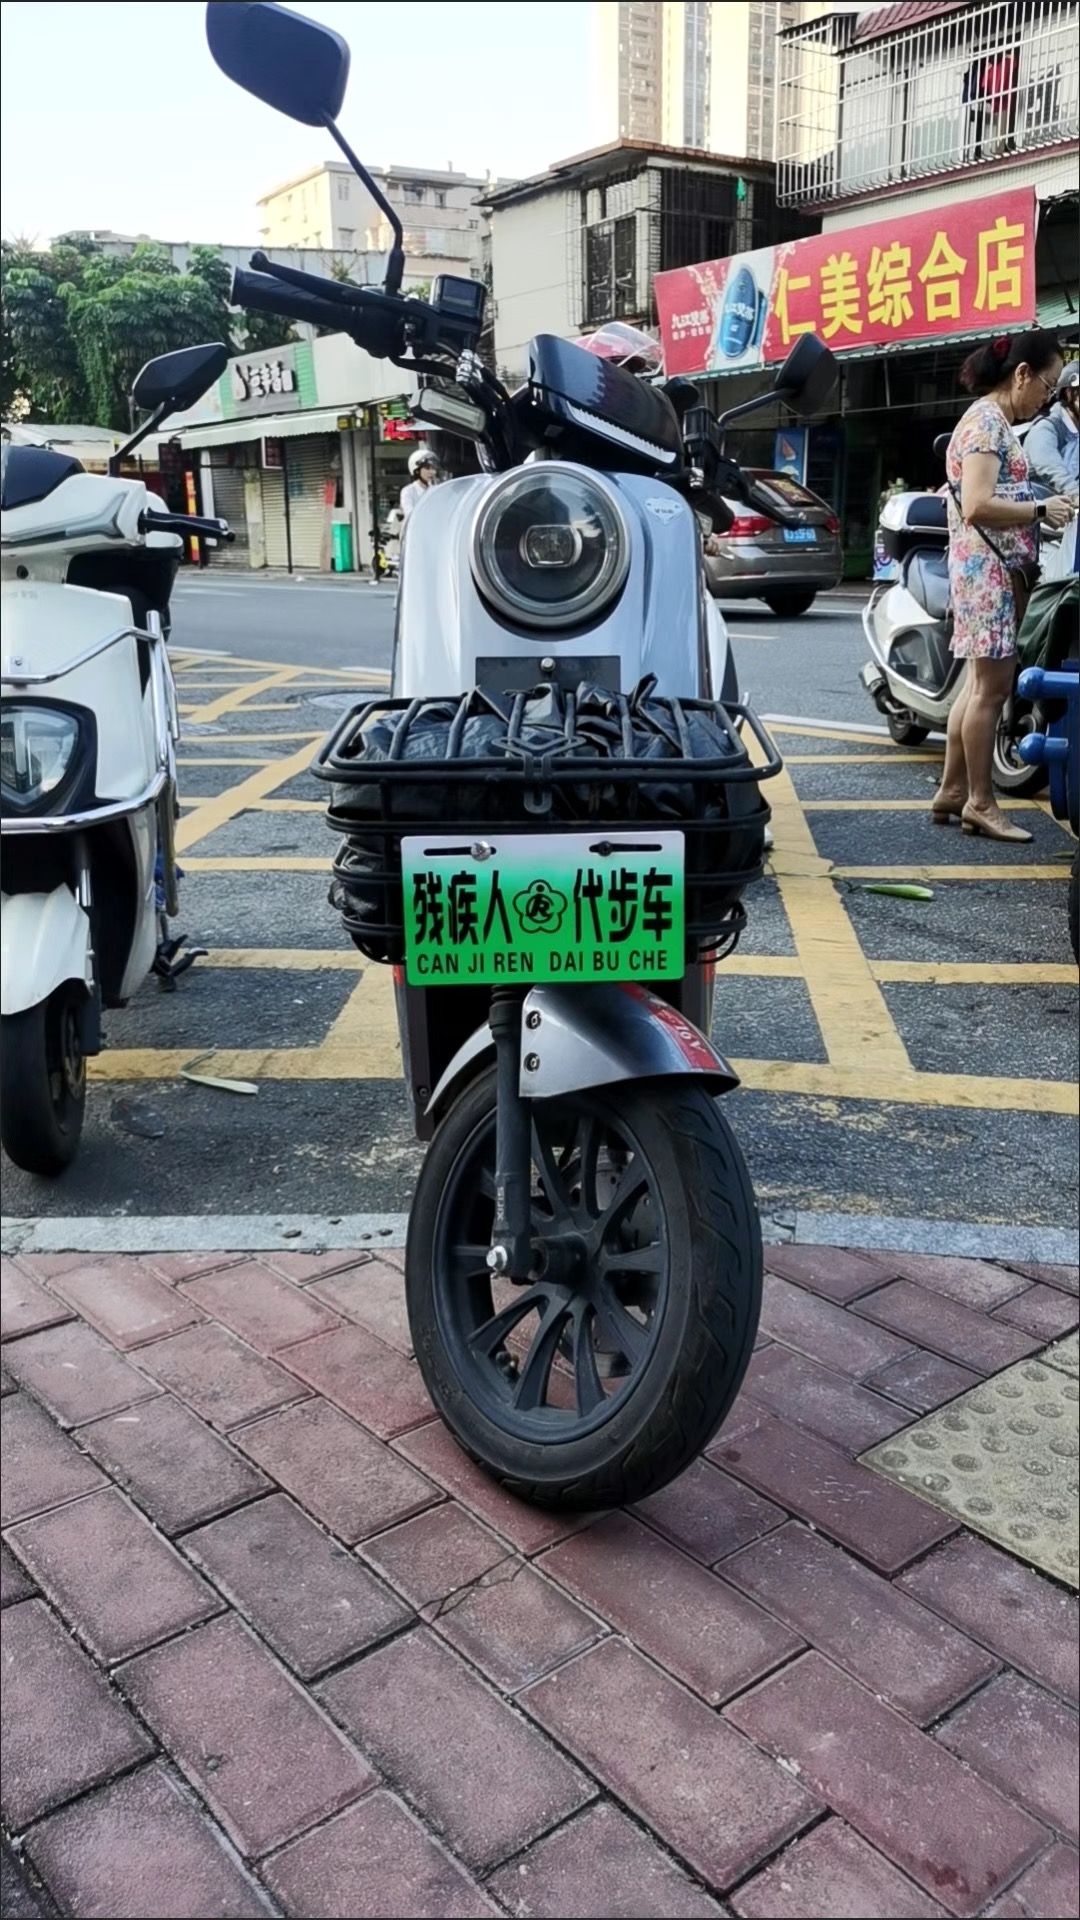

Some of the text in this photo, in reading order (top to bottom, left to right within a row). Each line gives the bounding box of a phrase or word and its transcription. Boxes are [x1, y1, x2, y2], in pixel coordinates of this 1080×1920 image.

[775, 216, 1025, 345] 仁美综合店
[413, 867, 673, 945] 残疾人 代步车
[417, 950, 667, 974] CAN JI REN DAI BU CHE
